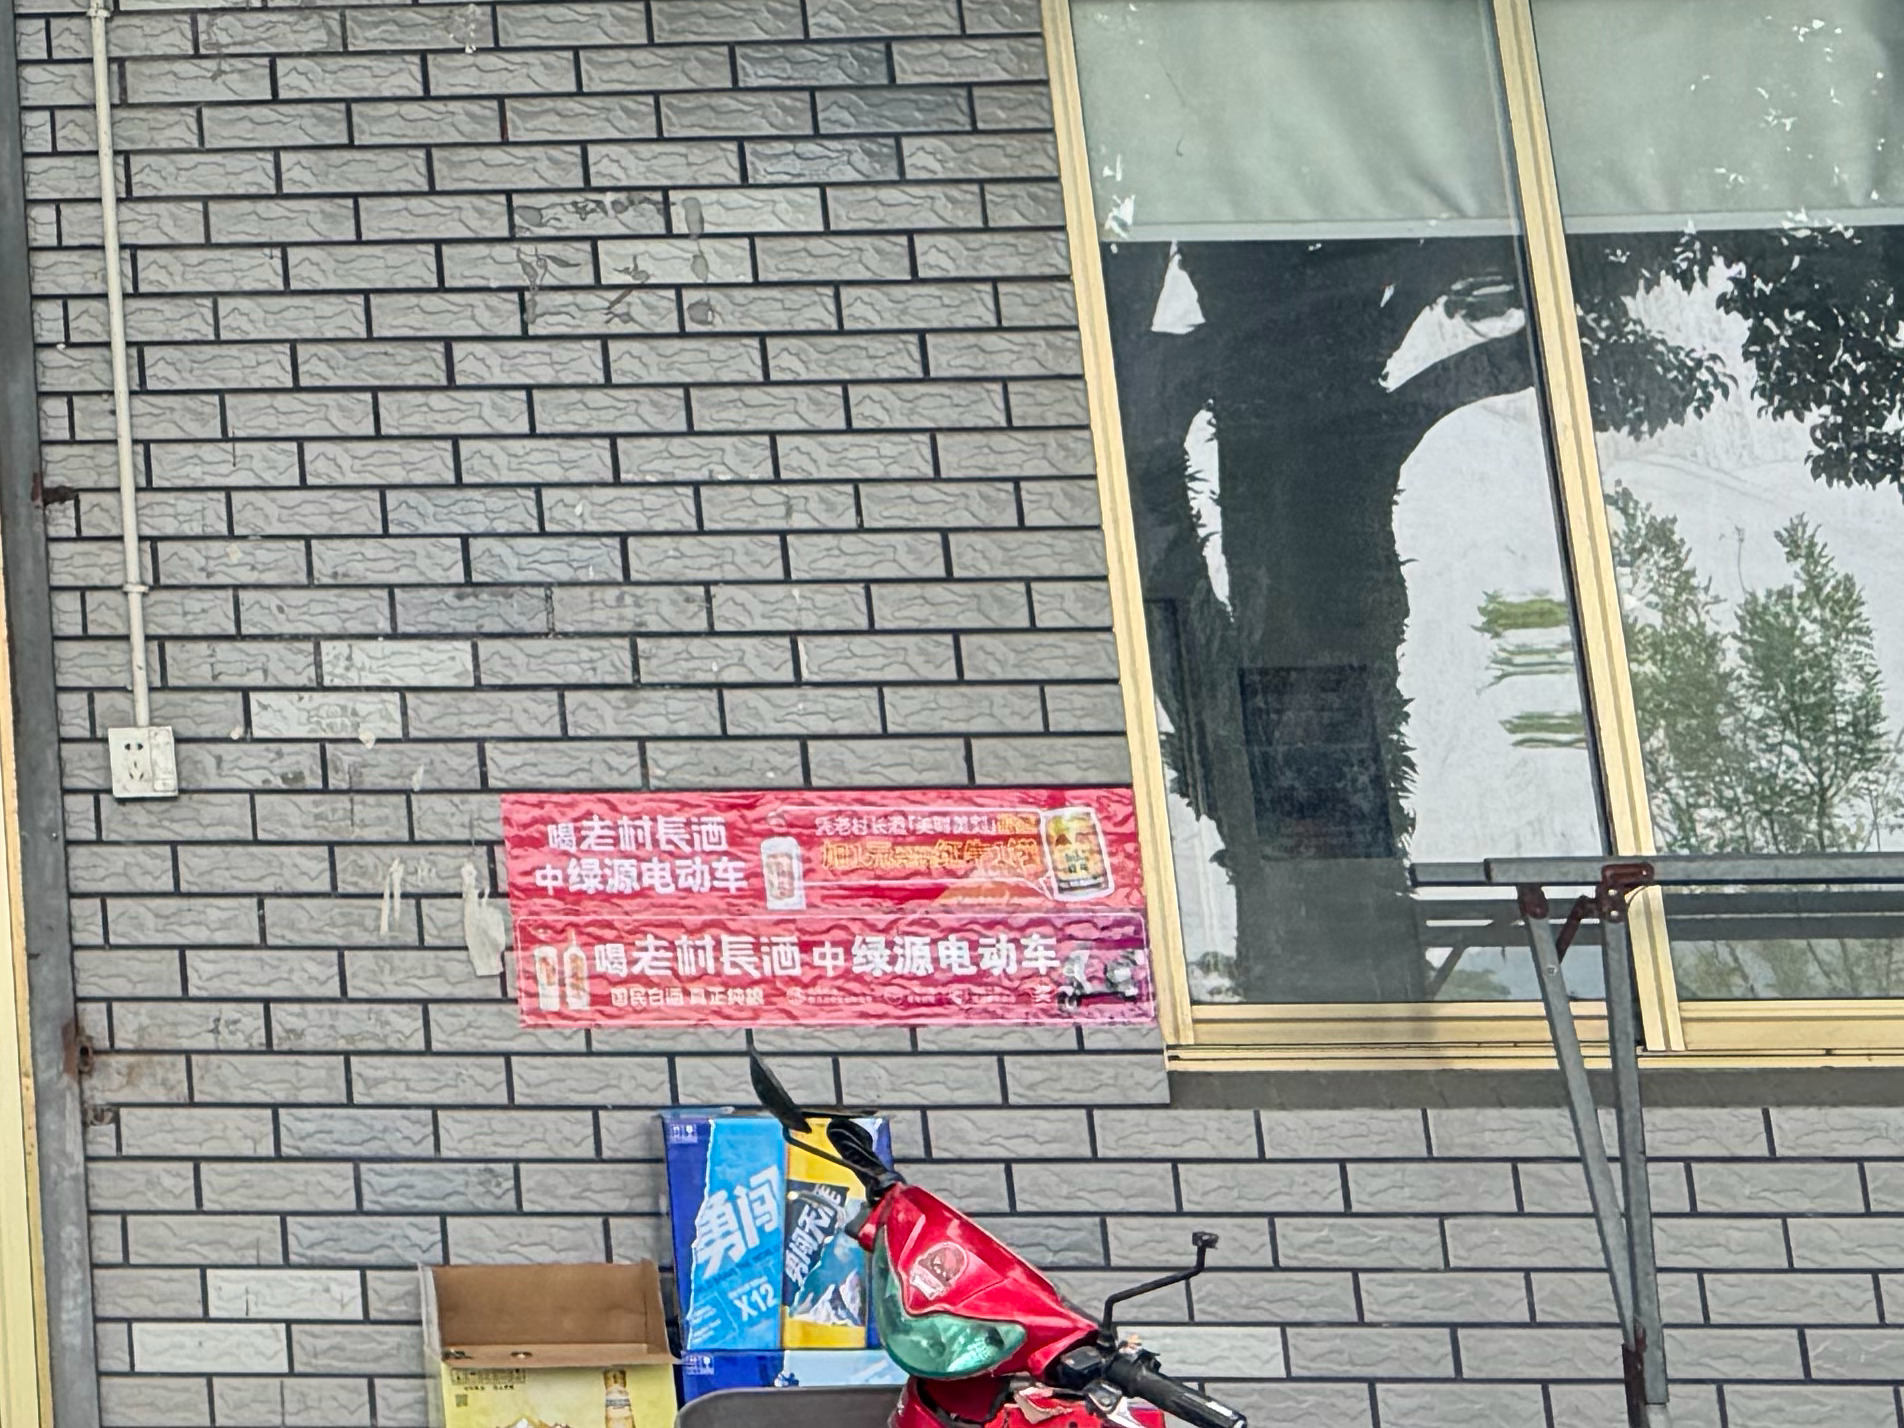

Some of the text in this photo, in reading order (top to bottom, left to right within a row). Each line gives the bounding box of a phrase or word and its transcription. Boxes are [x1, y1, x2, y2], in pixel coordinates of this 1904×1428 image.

[535, 856, 748, 895] 中绿源电动车
[812, 933, 1061, 977] 中绿源电动车
[693, 1164, 780, 1280] 勇闯
